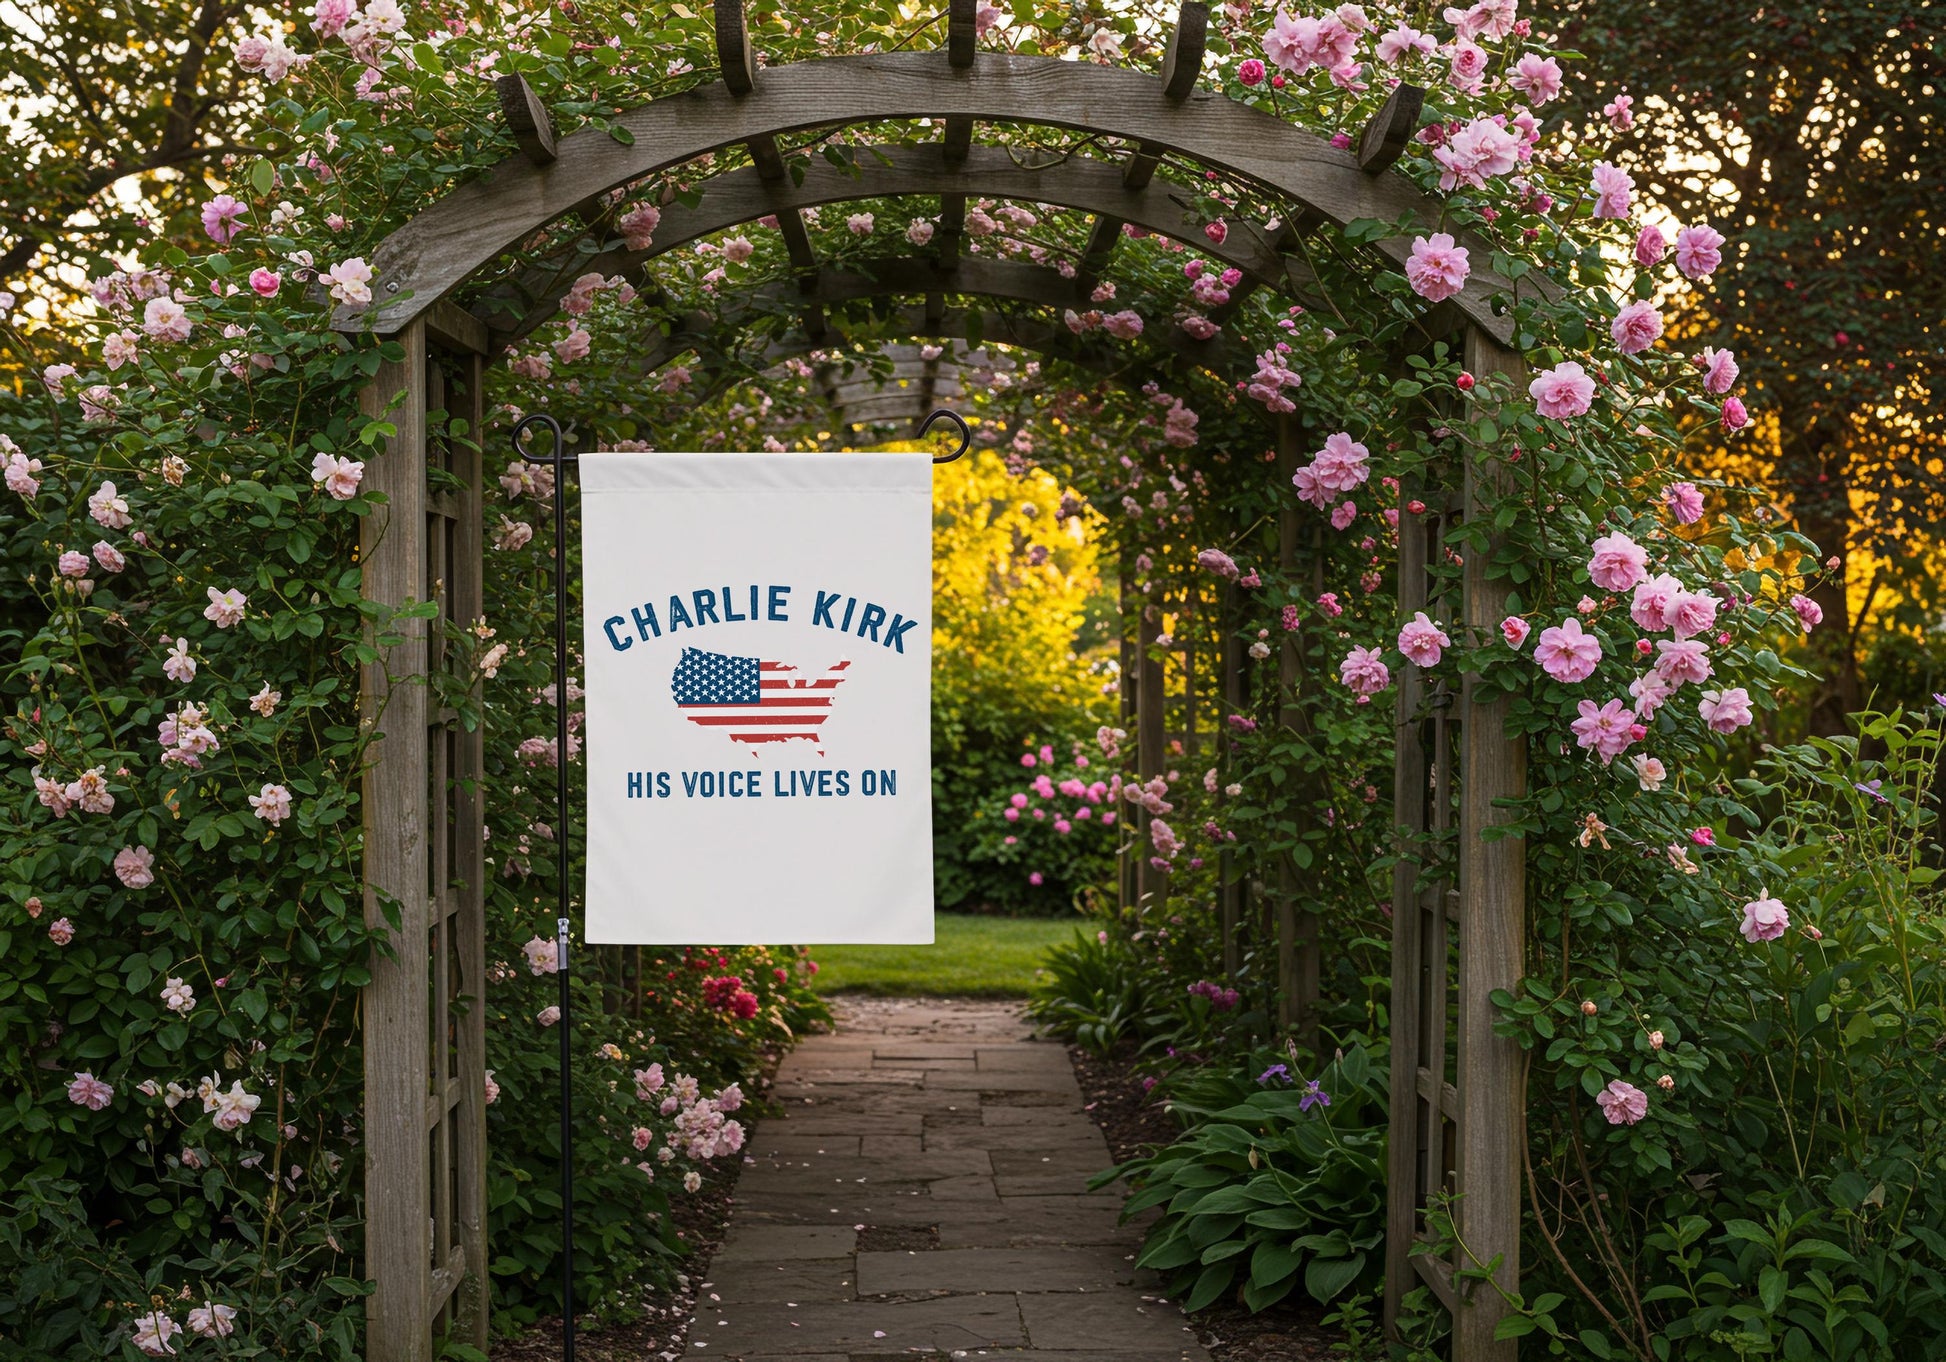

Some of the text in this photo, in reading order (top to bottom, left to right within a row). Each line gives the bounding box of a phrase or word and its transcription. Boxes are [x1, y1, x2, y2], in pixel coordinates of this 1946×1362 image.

[602, 584, 919, 655] CHARLIE KIRK
[627, 769, 897, 799] HIS VOICE LIVES ON
